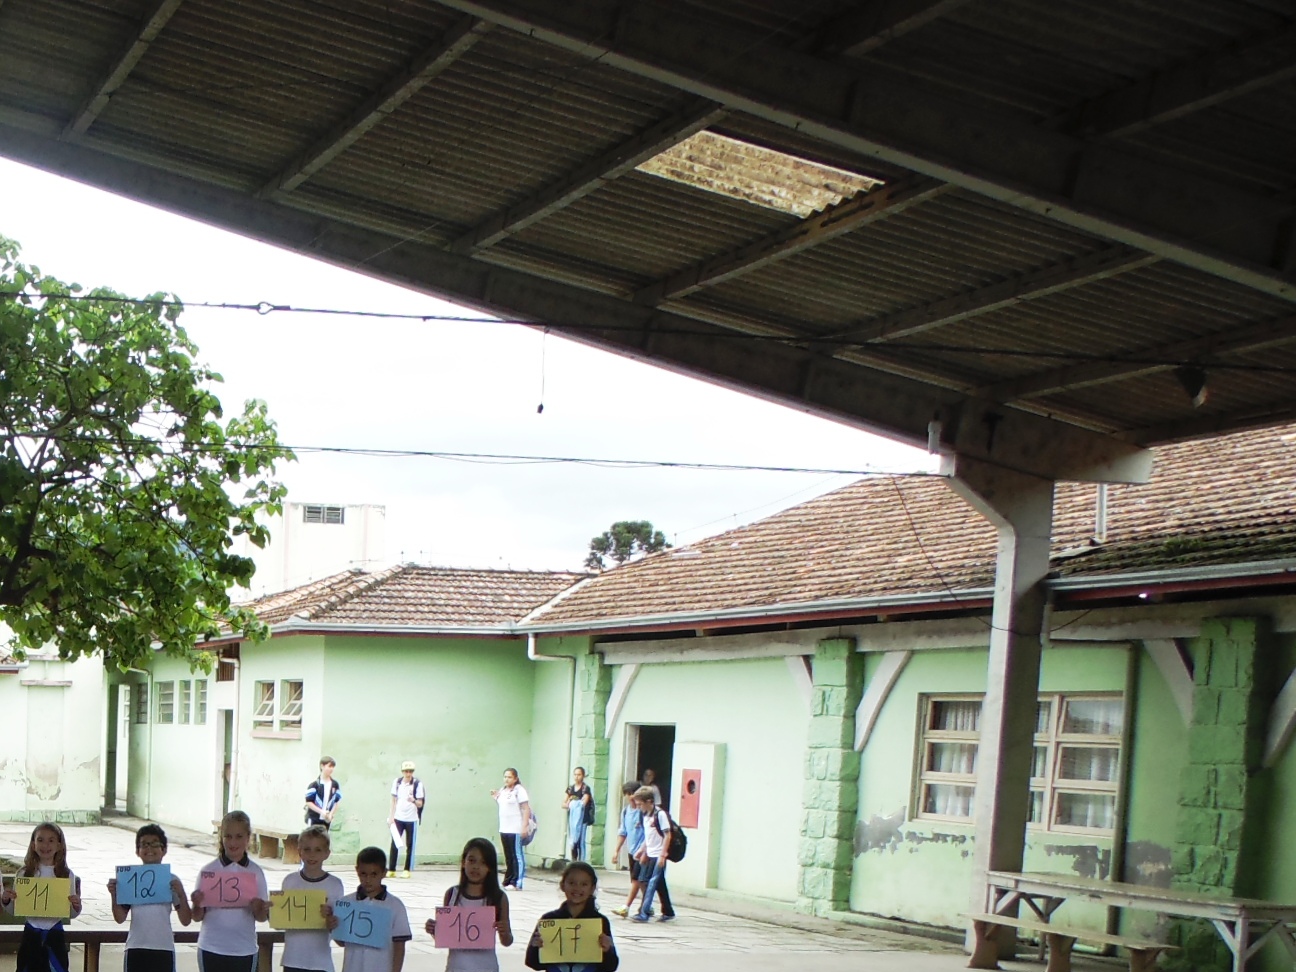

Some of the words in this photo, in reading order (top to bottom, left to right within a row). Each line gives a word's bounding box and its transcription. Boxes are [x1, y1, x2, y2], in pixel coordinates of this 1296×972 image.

[15, 877, 30, 885] FOTO
[126, 869, 156, 899] 12
[201, 871, 216, 879] FOTO
[26, 882, 49, 911] 11
[210, 876, 241, 903] 13
[280, 895, 307, 921] 14
[335, 900, 351, 908] FOTO
[343, 908, 373, 939] 15
[449, 911, 480, 942] 16
[538, 920, 555, 928] FOTO
[551, 925, 581, 955] 17
